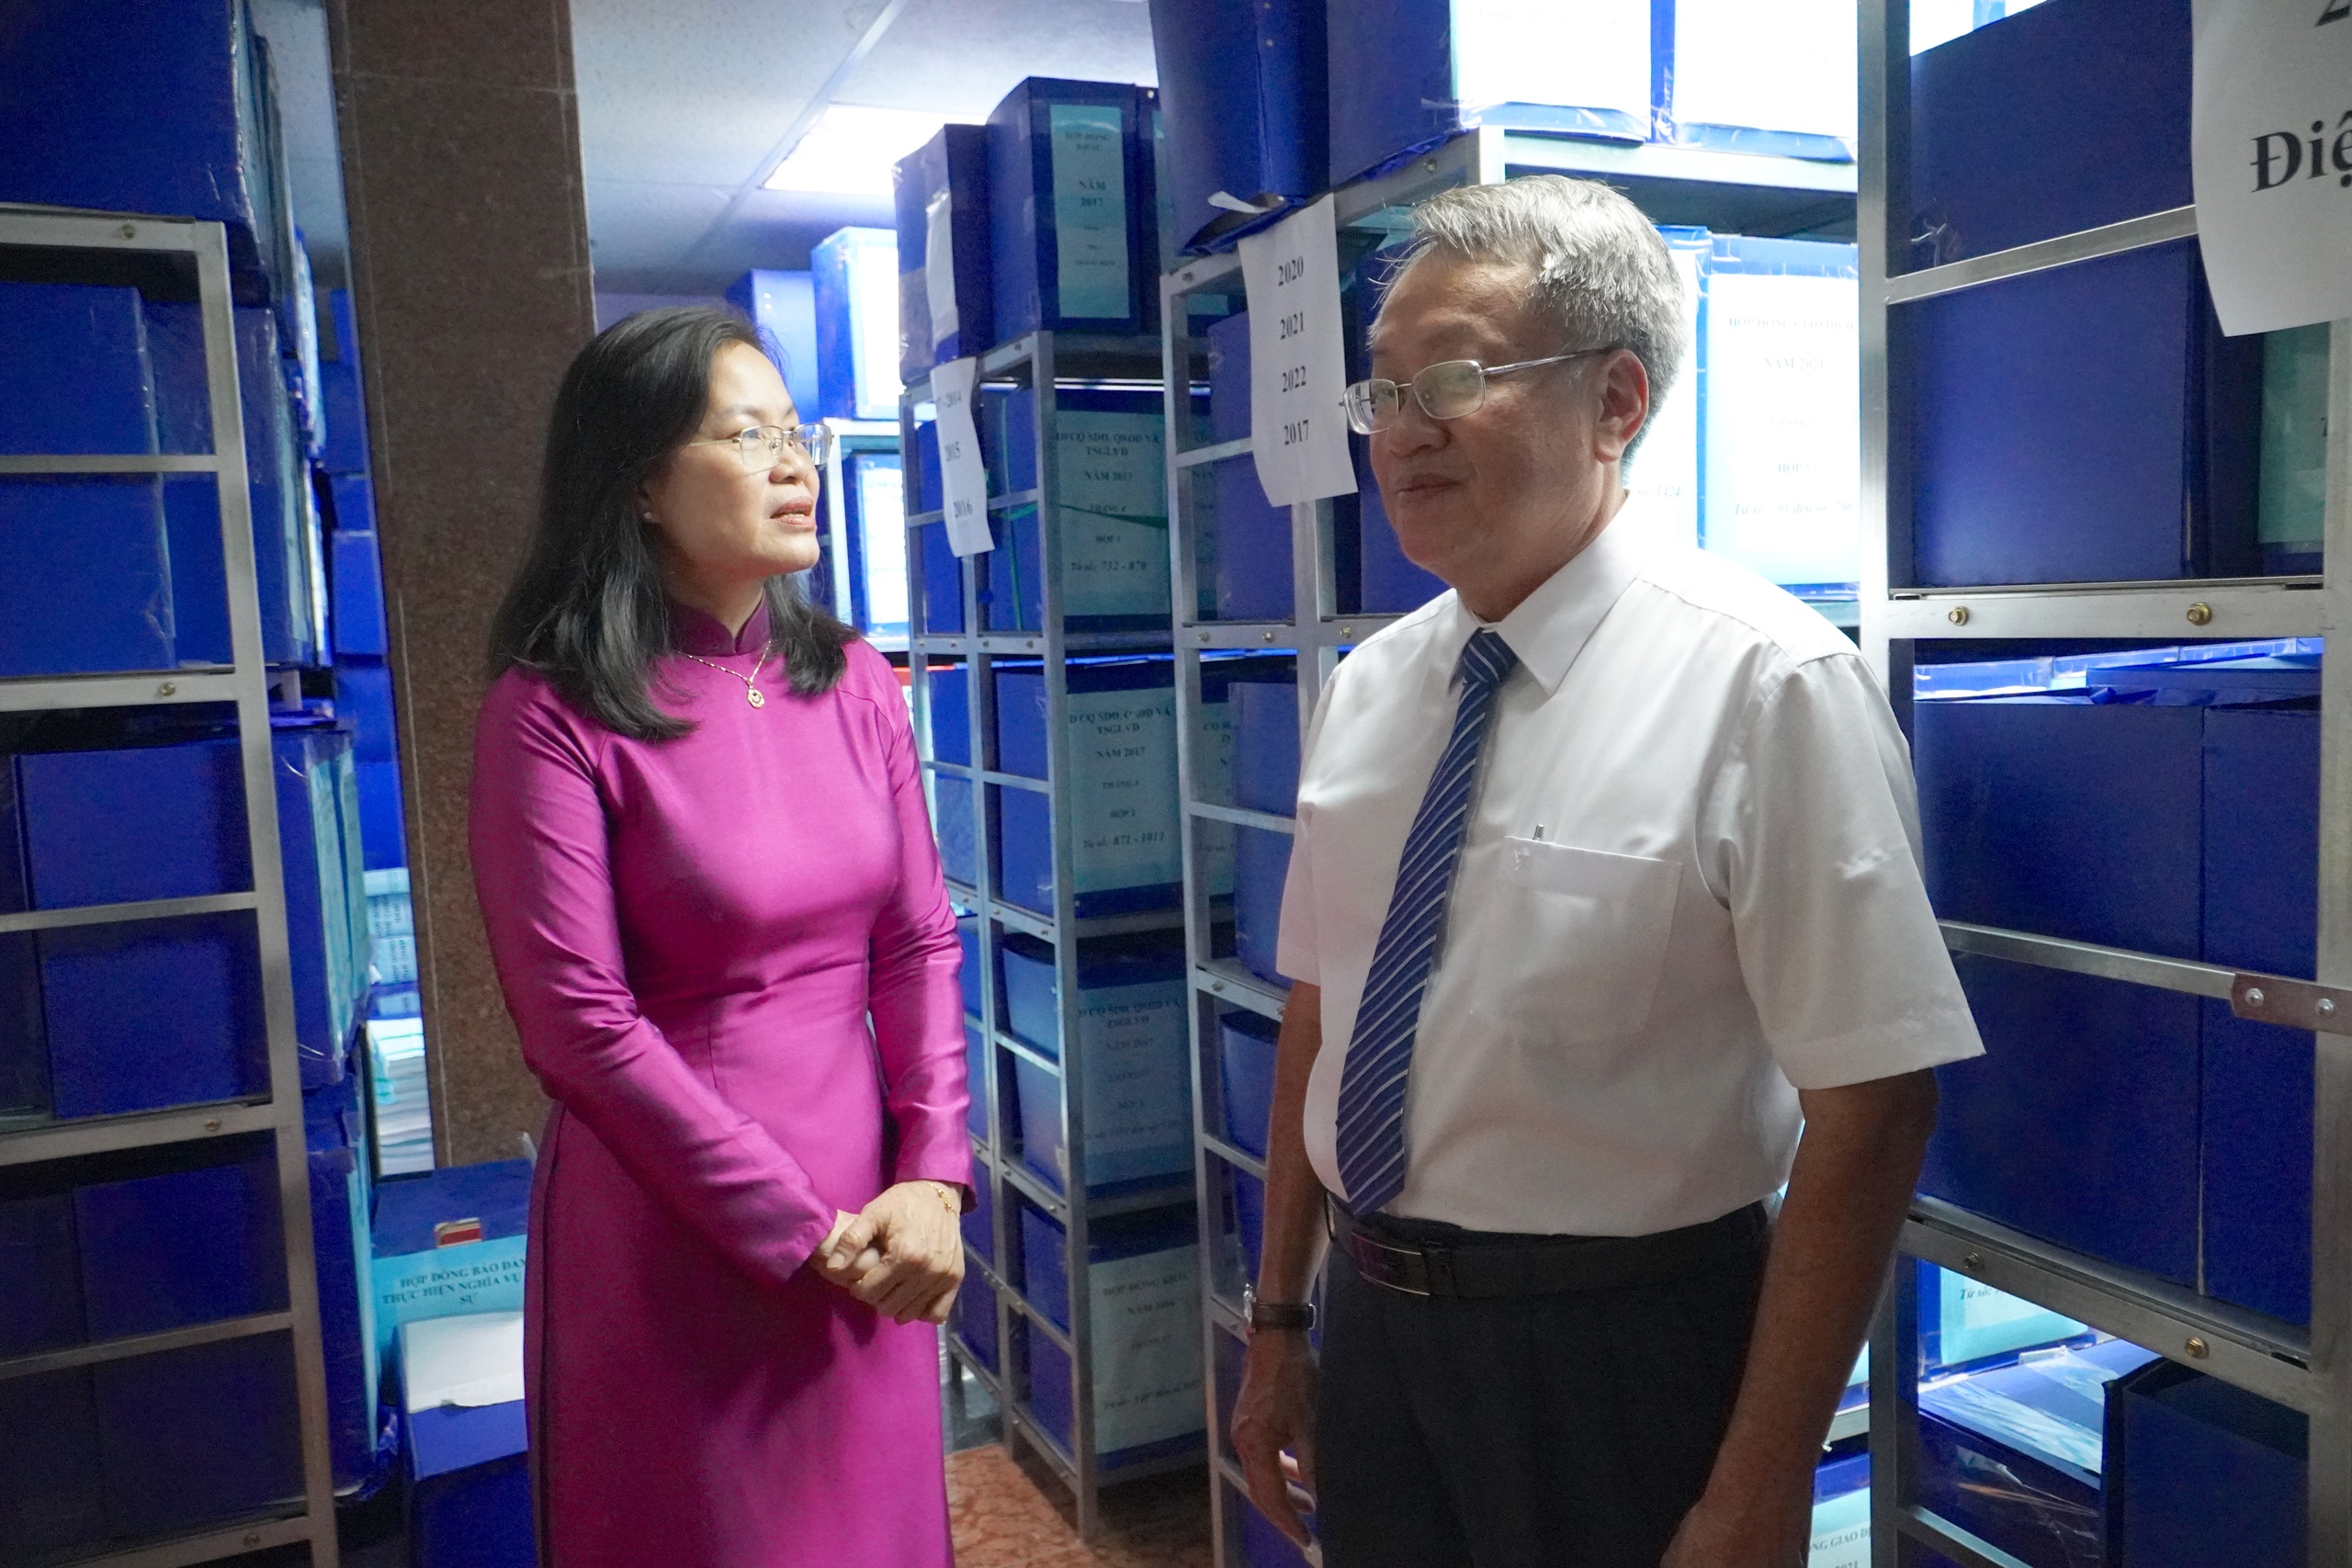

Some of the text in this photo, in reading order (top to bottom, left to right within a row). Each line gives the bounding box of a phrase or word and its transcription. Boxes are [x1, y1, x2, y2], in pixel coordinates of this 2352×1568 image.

[1278, 255, 1305, 287] 2020
[1280, 310, 1305, 340] 2021
[1282, 366, 1306, 393] 2022
[1283, 419, 1309, 446] 2017
[954, 499, 974, 518] 2016
[1830, 1530, 1859, 1547] GIAO
